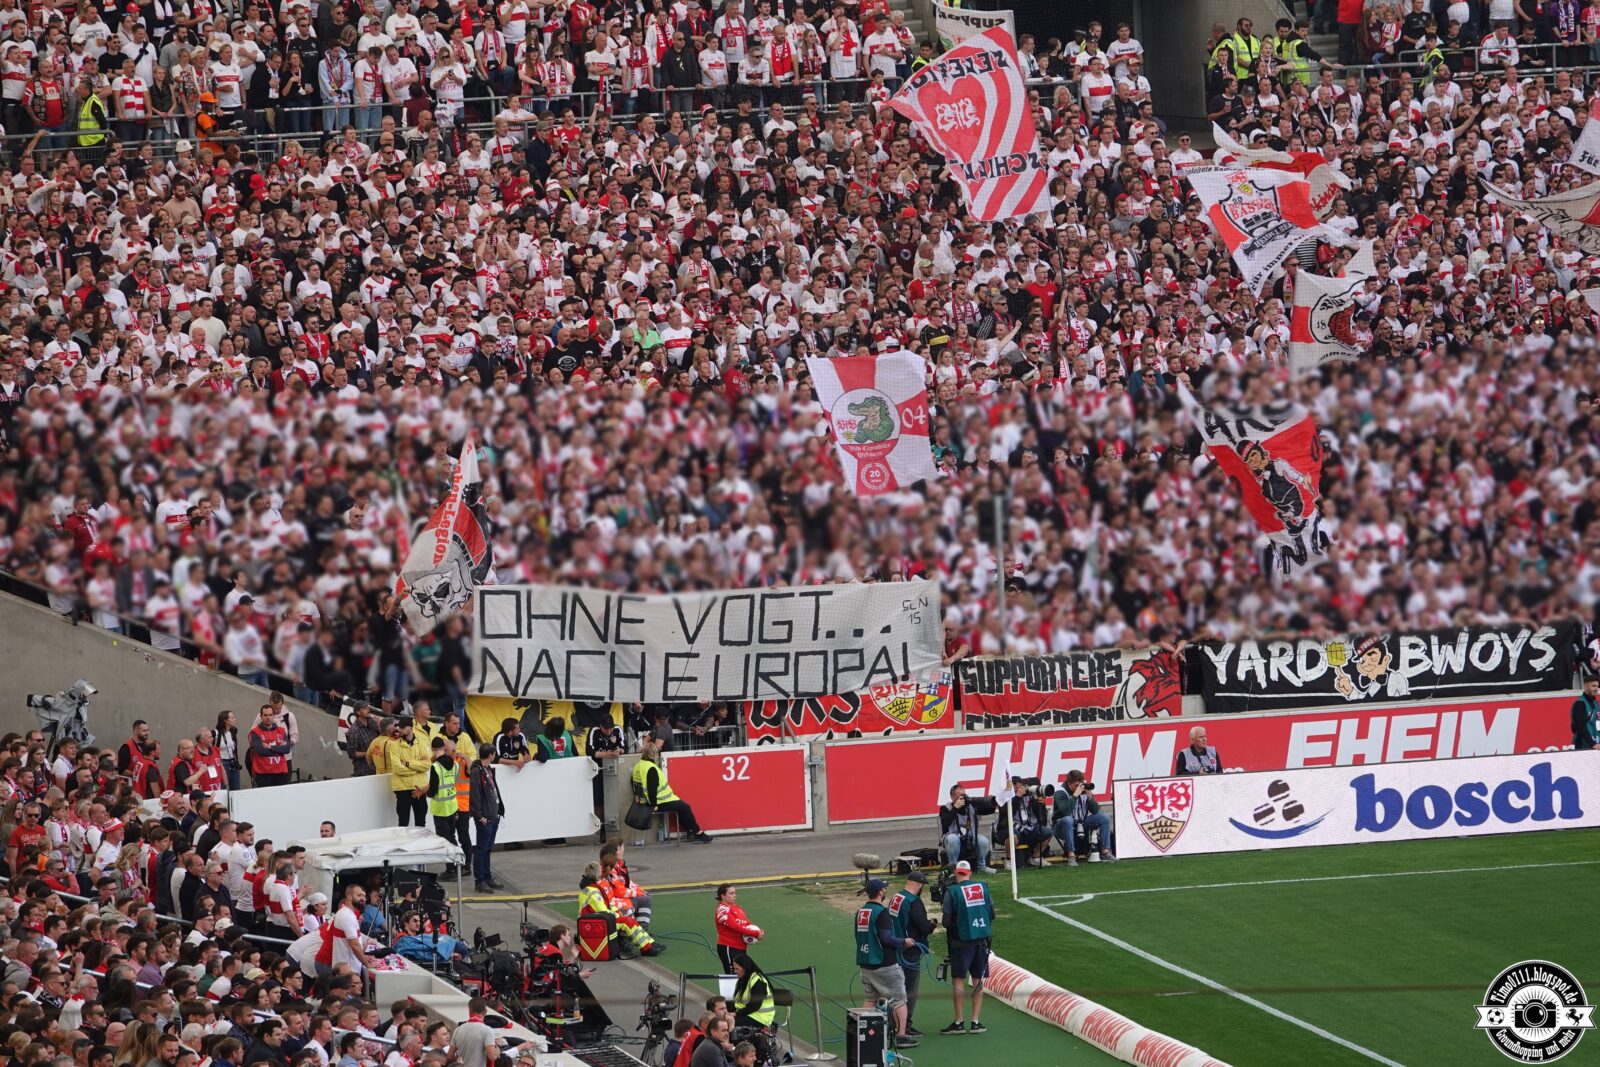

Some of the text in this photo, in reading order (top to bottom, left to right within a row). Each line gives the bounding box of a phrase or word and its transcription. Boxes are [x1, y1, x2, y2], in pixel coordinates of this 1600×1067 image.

[901, 404, 926, 429] 04
[479, 589, 647, 646] OHNE
[477, 642, 911, 702] NACH EUROPA!
[959, 650, 1123, 695] SUPPORTERS
[1203, 625, 1558, 690] YARD BWOYS
[267, 755, 281, 765] TV
[1283, 707, 1521, 770] EHEIM
[722, 755, 751, 782] 32
[937, 729, 1177, 807] EHEIM
[1349, 761, 1584, 833] bosch
[972, 917, 987, 928] 41
